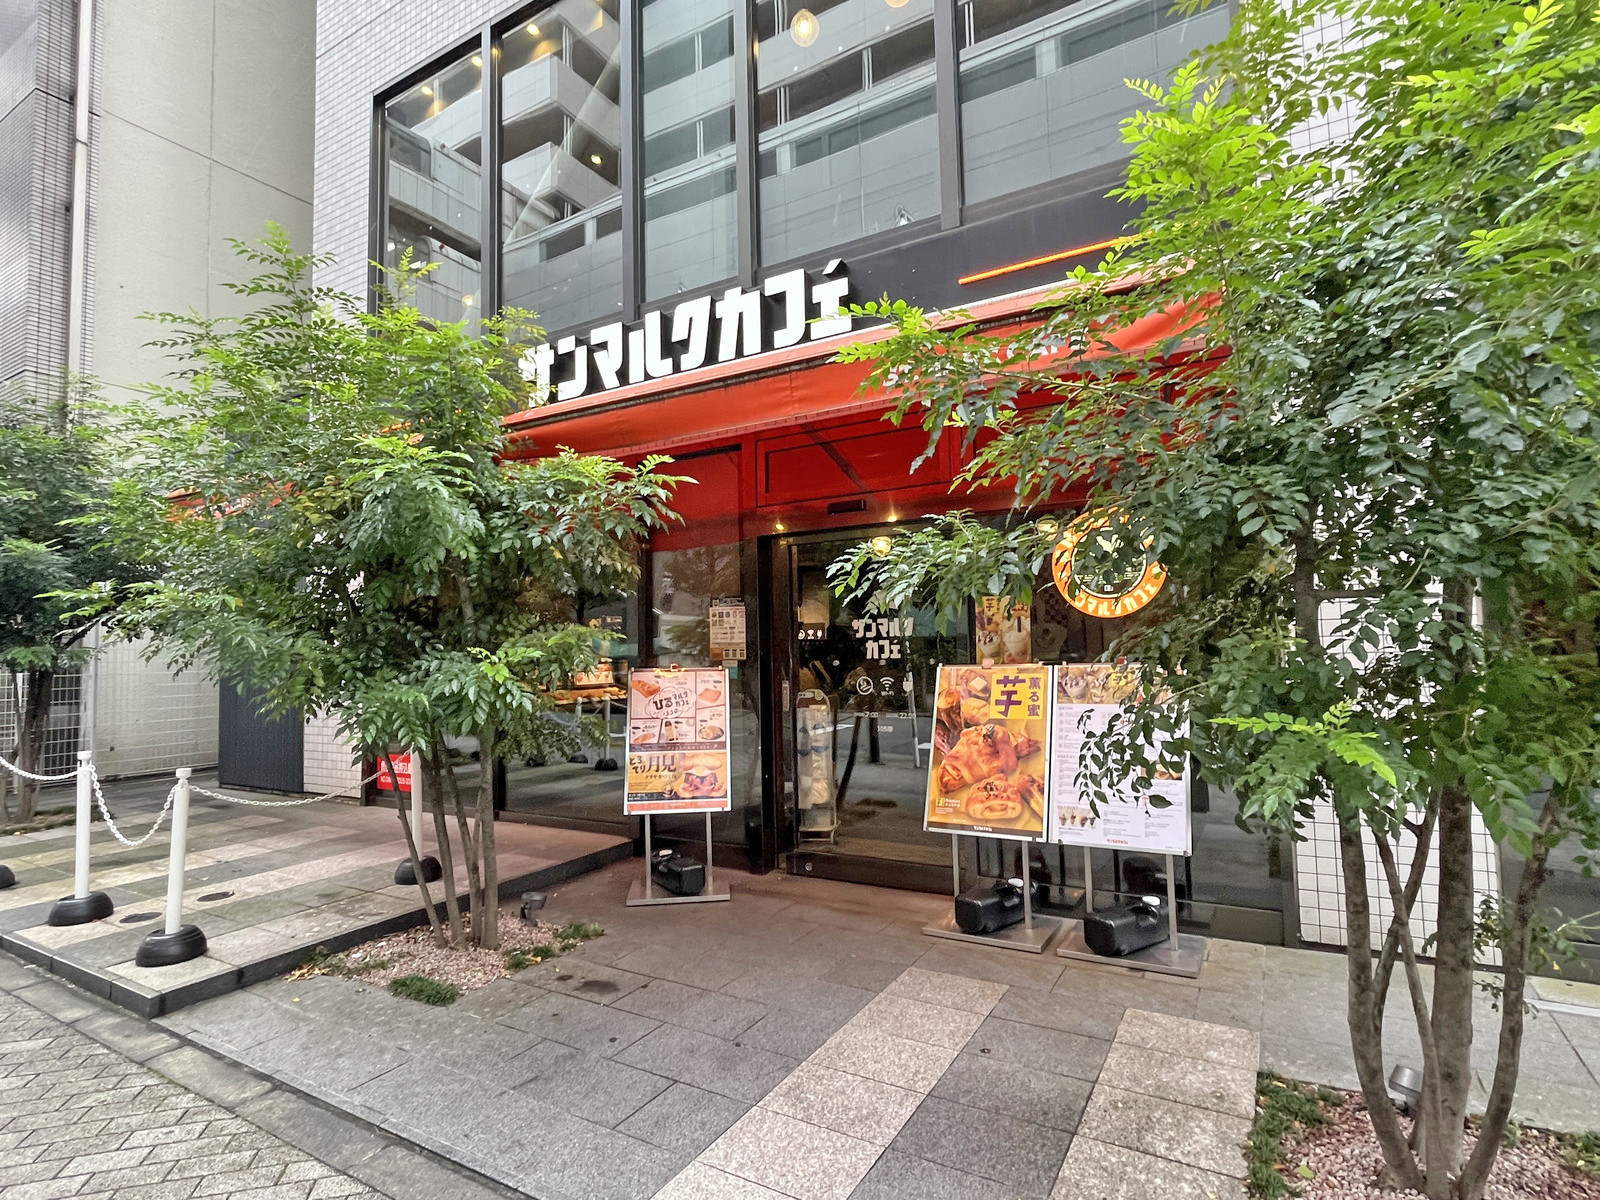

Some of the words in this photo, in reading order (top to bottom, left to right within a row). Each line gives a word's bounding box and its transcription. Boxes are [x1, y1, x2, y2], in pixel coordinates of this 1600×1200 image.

[518, 257, 853, 407] サンマルクカフェ
[865, 639, 902, 659] カフェ
[994, 675, 1027, 718] 芋
[1027, 676, 1042, 717] 薫る蜜
[645, 754, 677, 773] 月見
